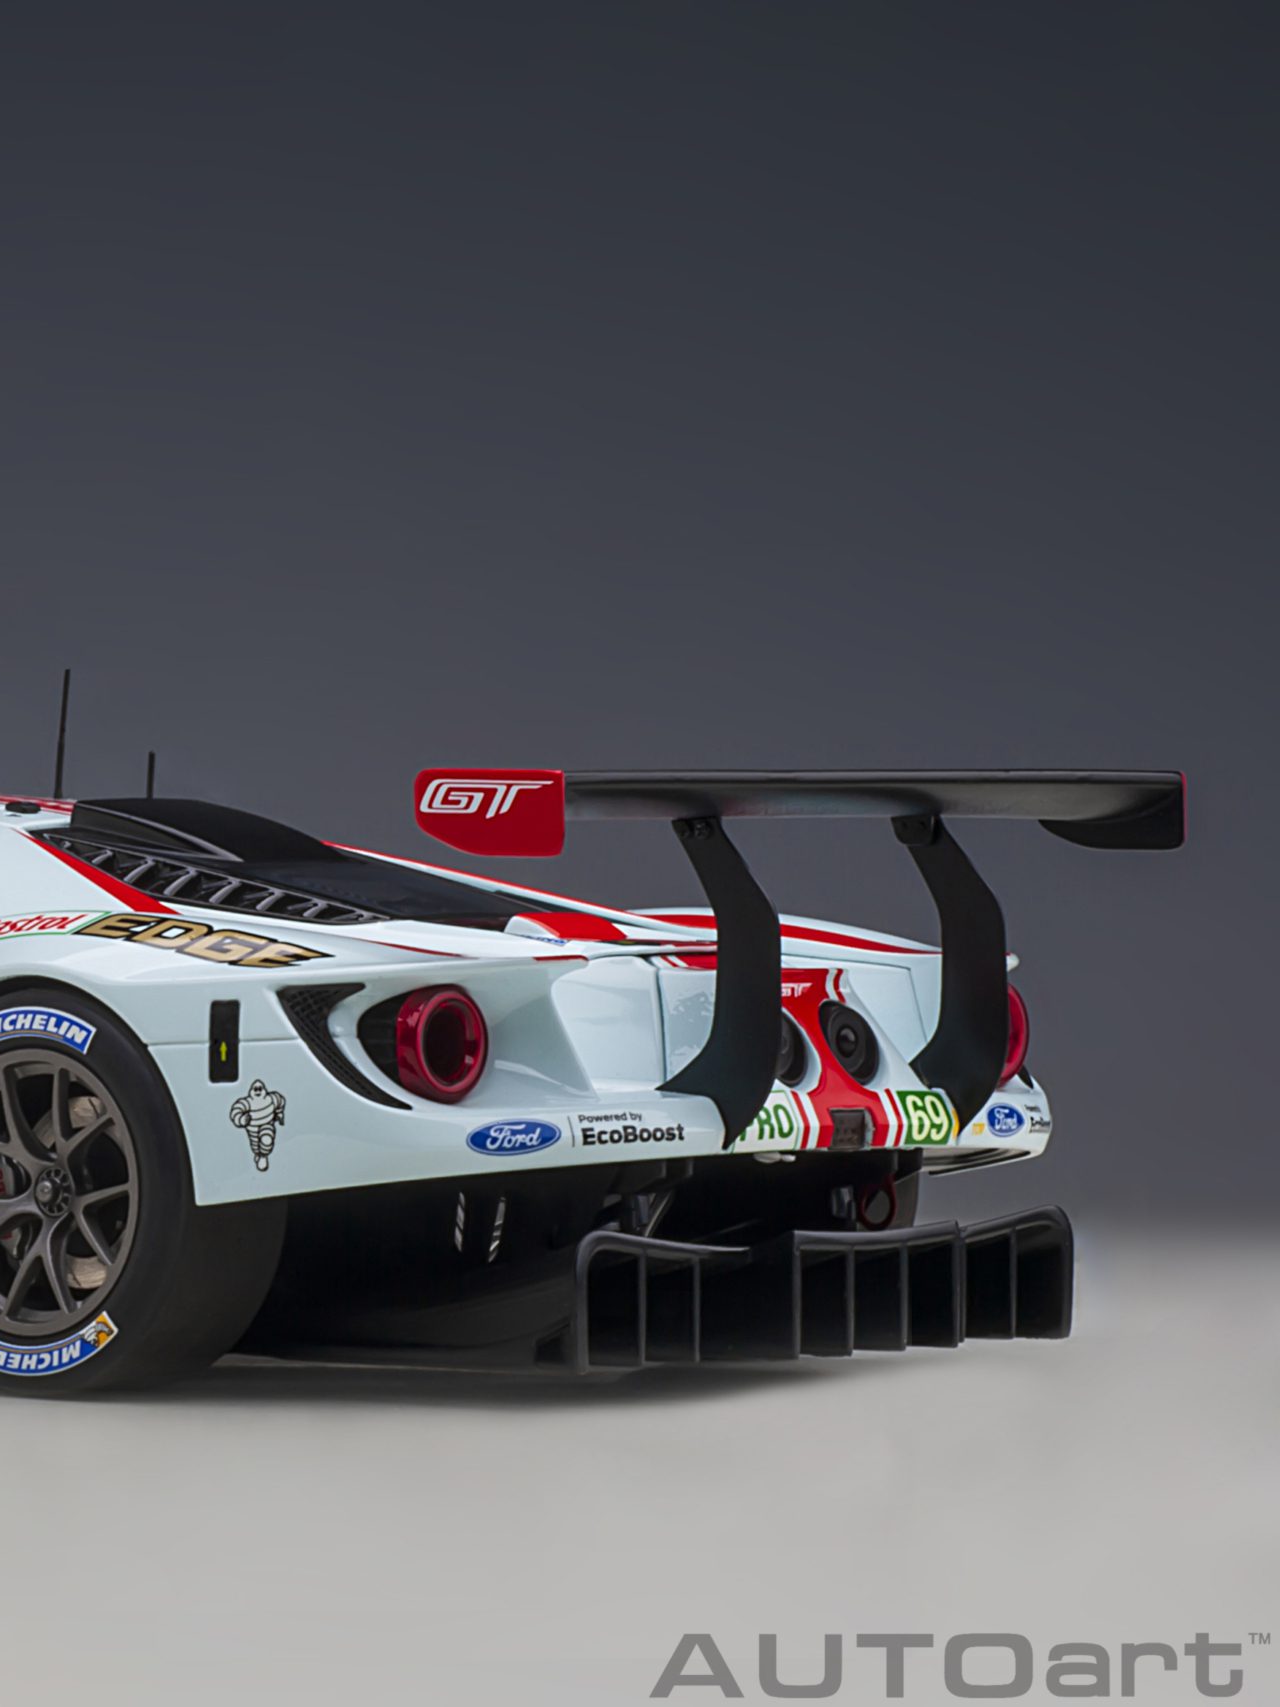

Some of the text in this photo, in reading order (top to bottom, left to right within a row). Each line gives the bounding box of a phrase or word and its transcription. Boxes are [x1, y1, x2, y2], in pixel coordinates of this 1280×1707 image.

[420, 779, 554, 819] GT
[71, 913, 336, 968] EDGE
[578, 1111, 642, 1124] Powered by
[581, 1123, 685, 1146] EcoBoost
[739, 1104, 794, 1141] RO
[905, 1094, 949, 1141] 69
[485, 1124, 542, 1149] Ford
